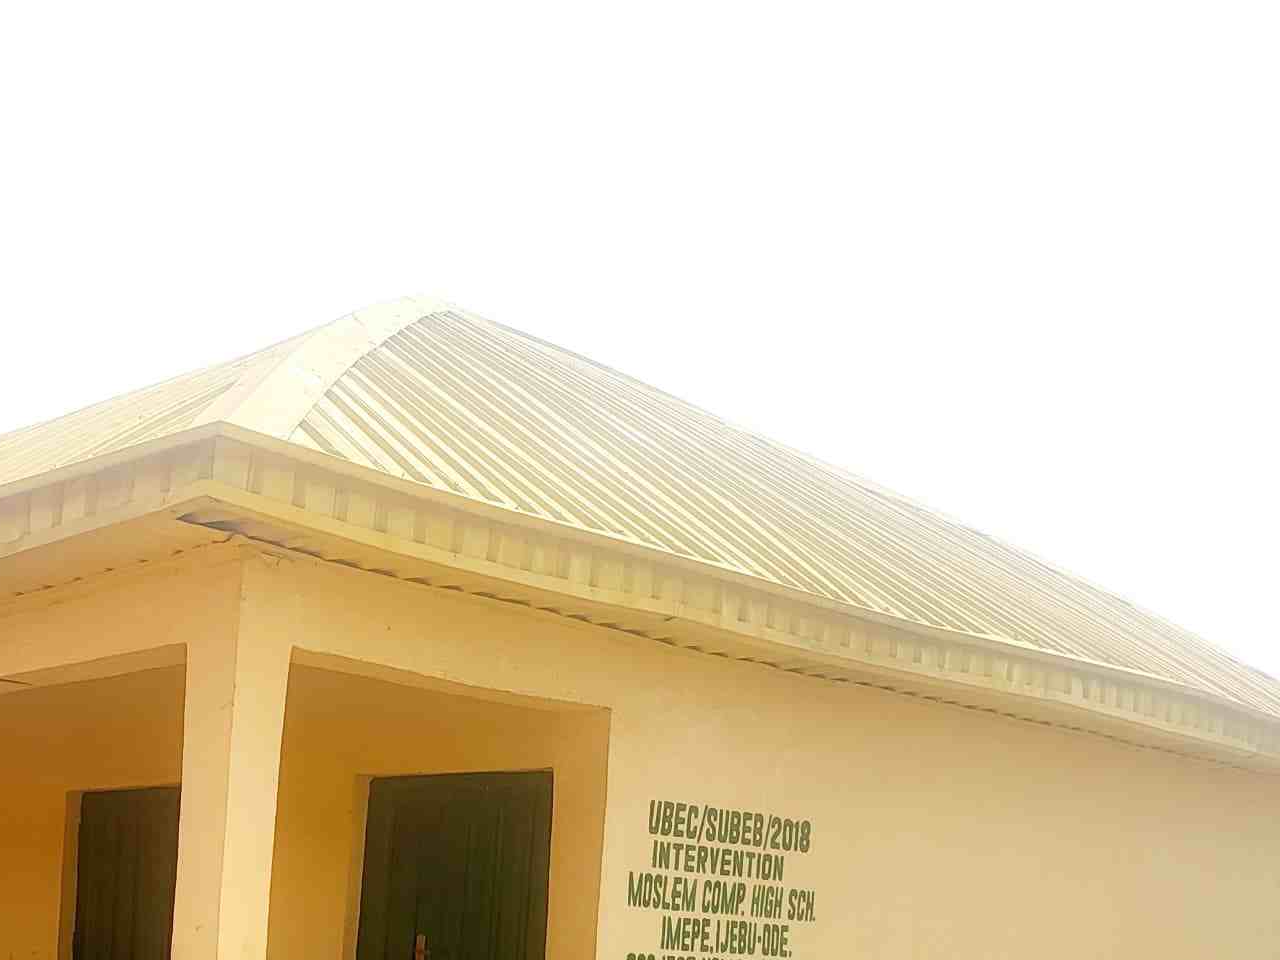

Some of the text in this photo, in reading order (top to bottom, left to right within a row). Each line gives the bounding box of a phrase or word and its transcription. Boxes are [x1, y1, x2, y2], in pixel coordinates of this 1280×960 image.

[648, 799, 812, 853] UBEC/SUBEB/2018
[652, 839, 784, 881] INTERVENTION
[627, 871, 816, 922] MOSLEM COMP. HIGH SCH.
